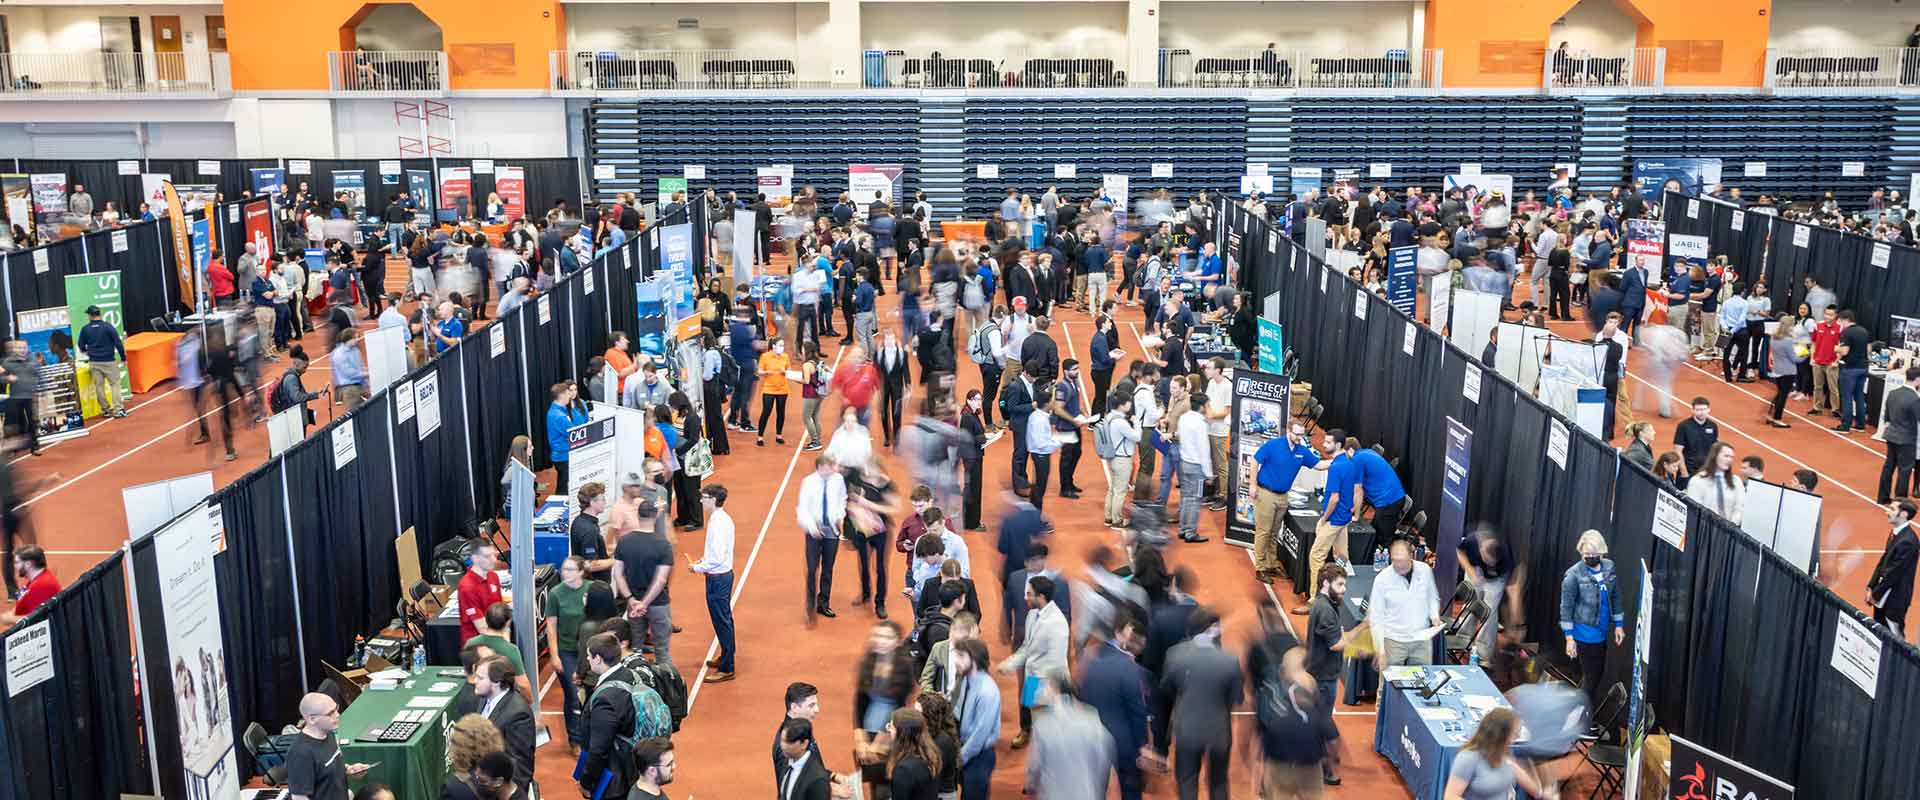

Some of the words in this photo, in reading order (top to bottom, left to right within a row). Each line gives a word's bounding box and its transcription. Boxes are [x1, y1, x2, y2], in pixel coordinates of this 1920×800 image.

[1674, 241, 1702, 249] JABIL
[1251, 381, 1288, 395] RETECH
[570, 427, 587, 443] CACI
